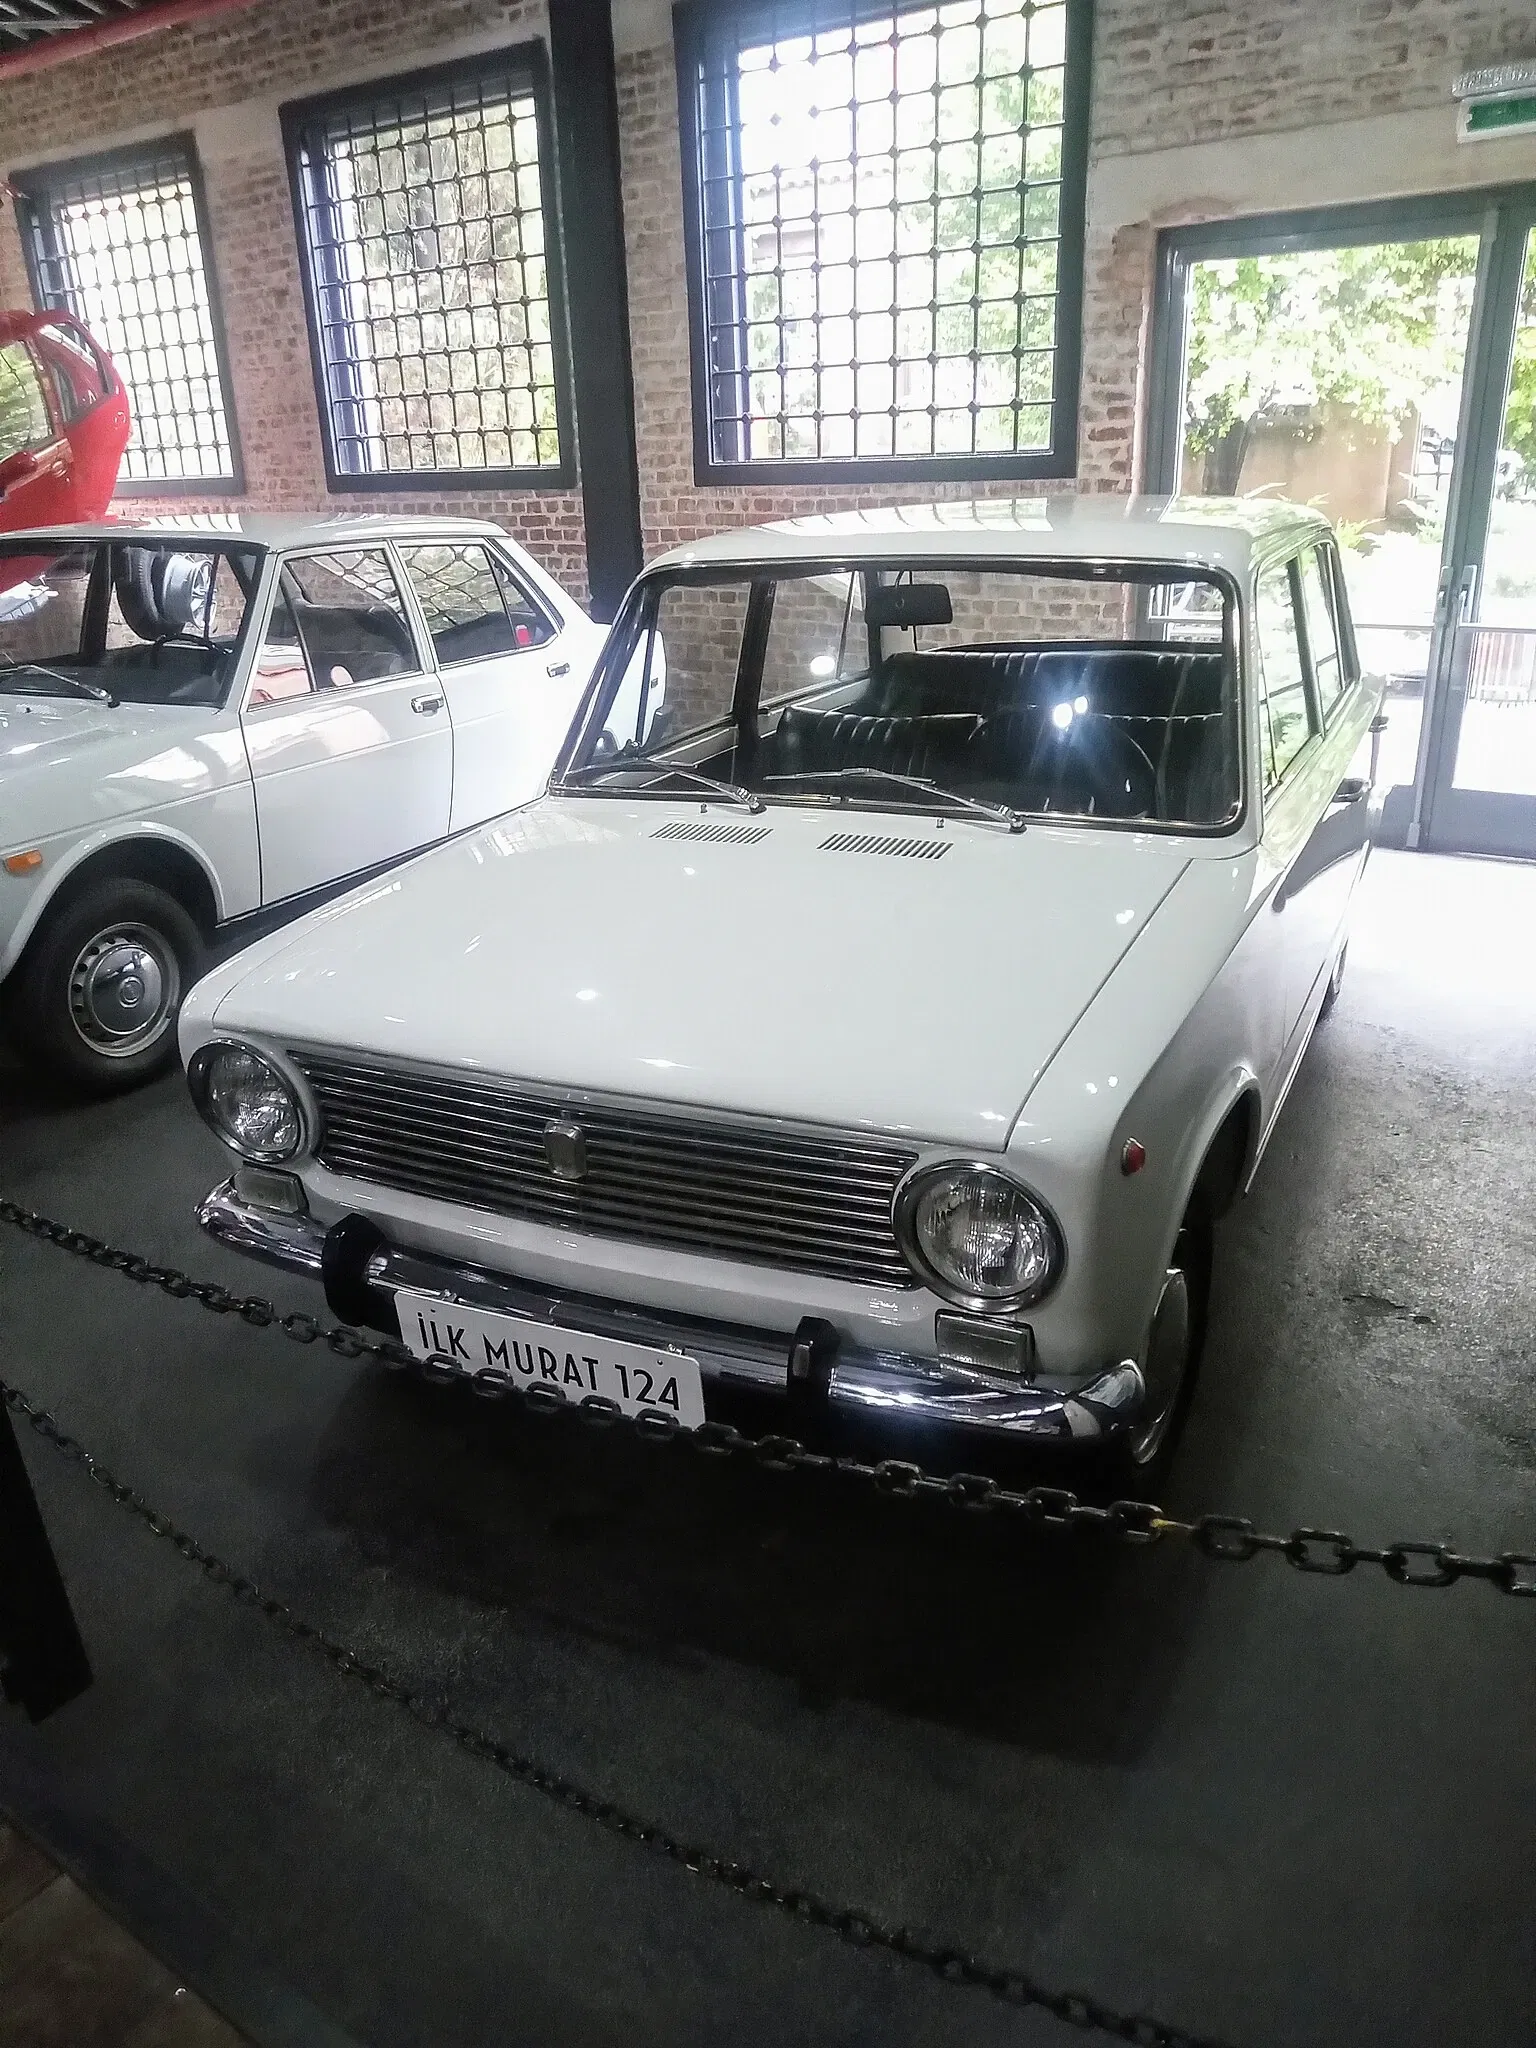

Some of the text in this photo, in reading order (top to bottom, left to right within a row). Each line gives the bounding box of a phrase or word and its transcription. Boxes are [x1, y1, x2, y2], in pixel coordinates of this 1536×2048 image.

[417, 1312, 680, 1411] İLK MURAT 124
